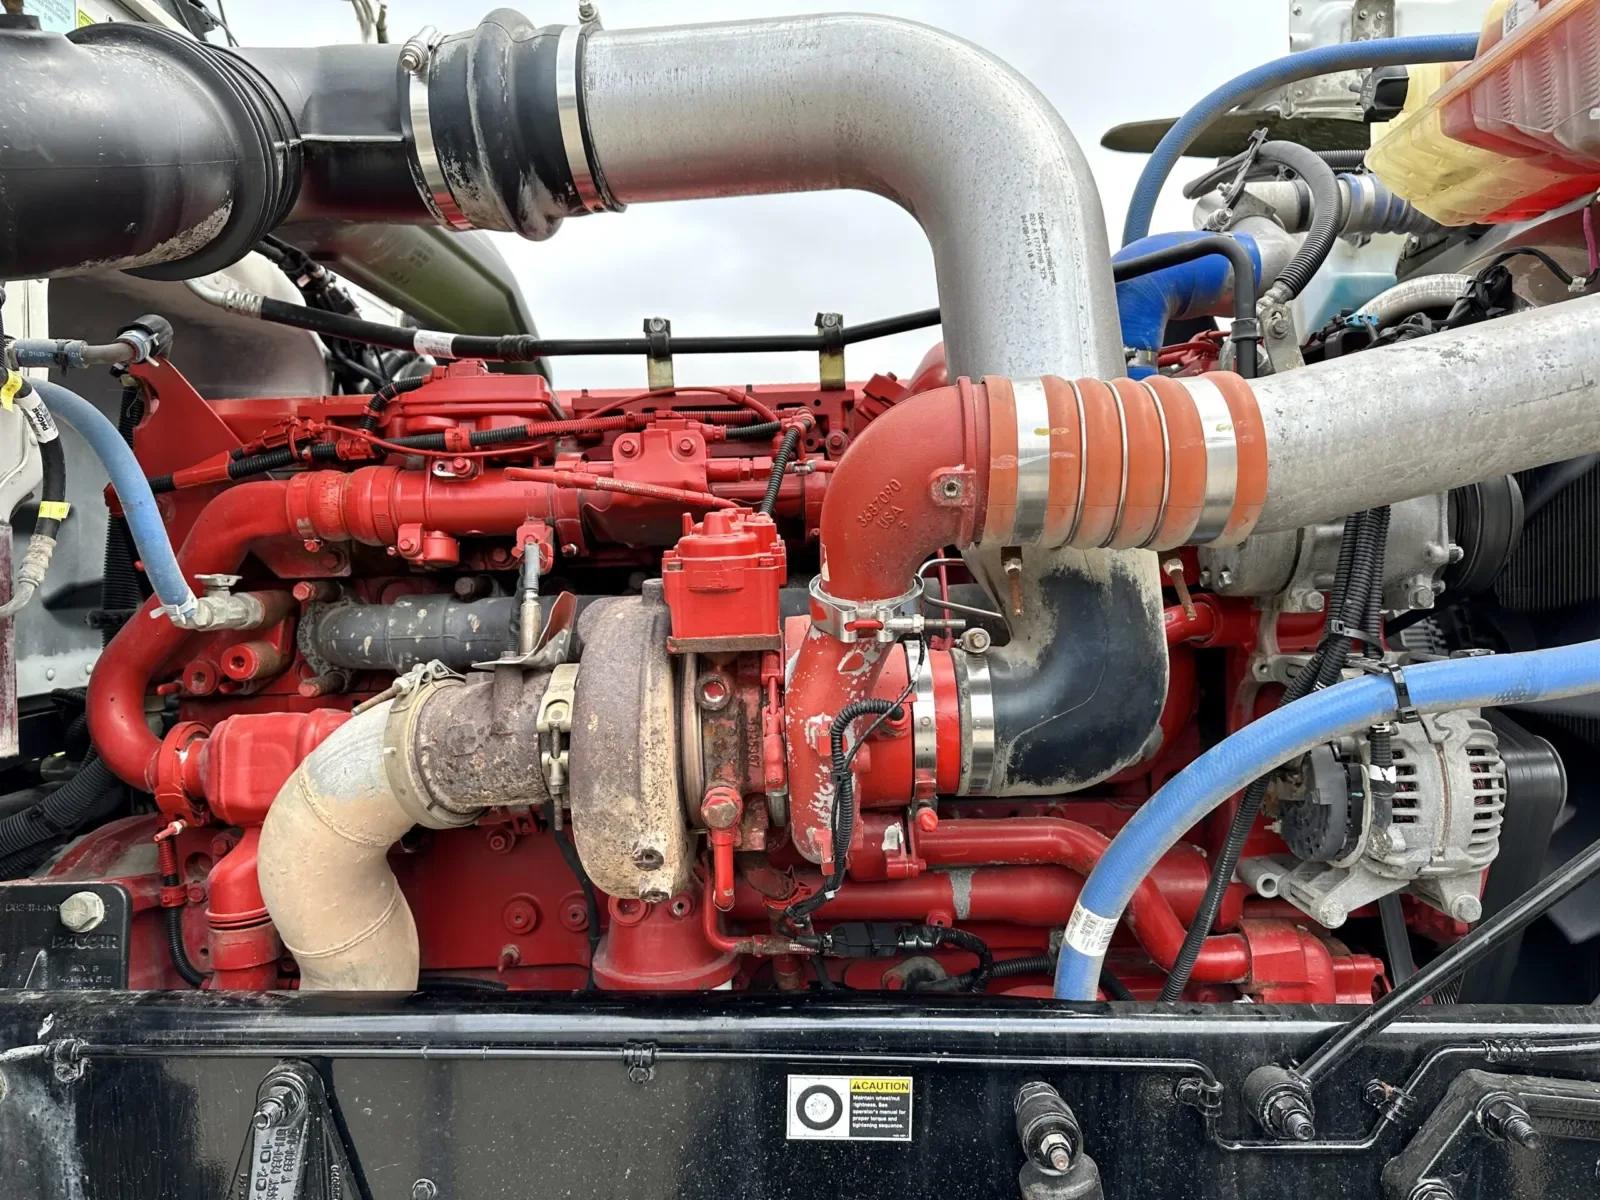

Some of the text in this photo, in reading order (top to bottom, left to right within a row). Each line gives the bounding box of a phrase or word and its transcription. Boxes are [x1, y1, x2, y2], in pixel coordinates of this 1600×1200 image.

[856, 478, 903, 527] 3687090
[876, 505, 905, 529] USA
[861, 1081, 909, 1091] CAUTION
